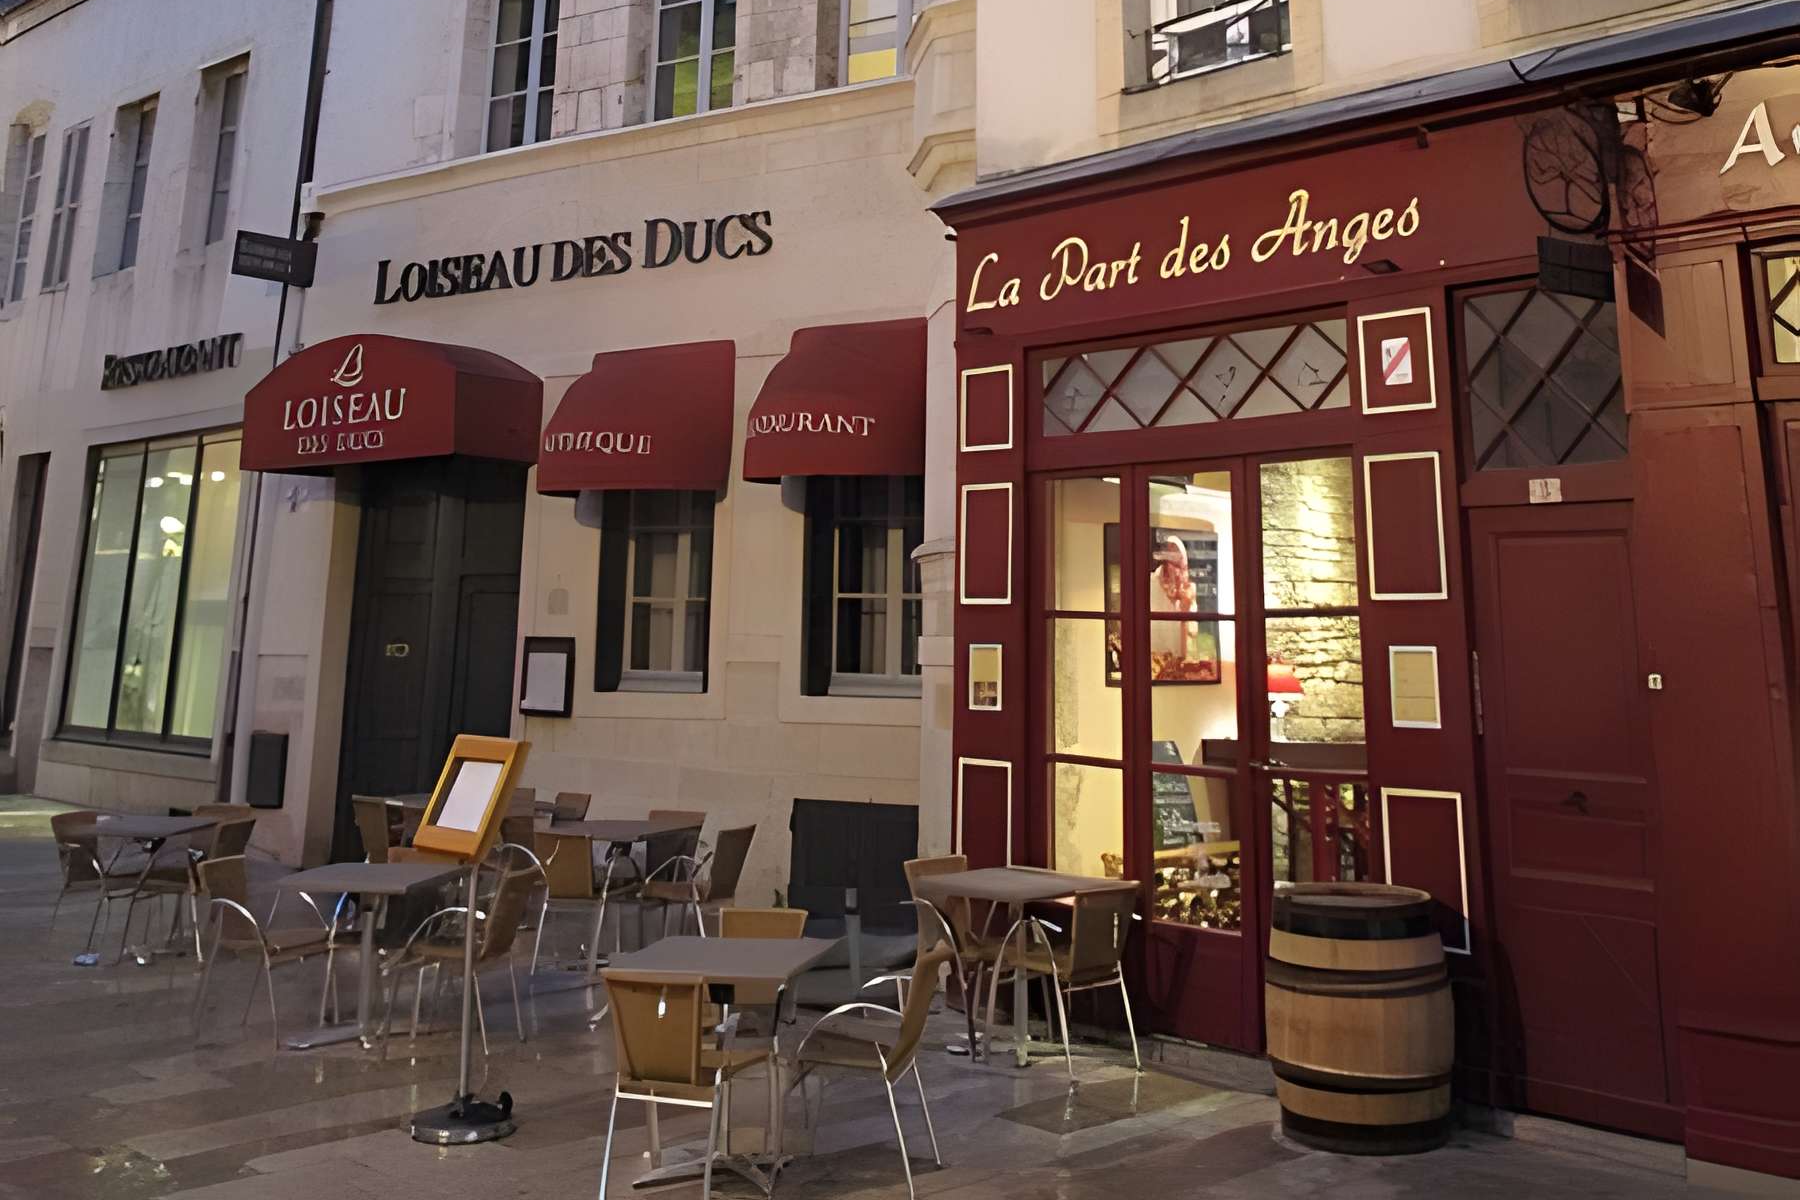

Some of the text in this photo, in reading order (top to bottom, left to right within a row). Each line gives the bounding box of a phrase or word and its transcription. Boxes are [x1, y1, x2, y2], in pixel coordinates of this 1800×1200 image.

[1719, 101, 1800, 177] A
[550, 231, 633, 283] DES
[641, 209, 774, 269] DUCS
[965, 188, 1421, 314] La Part des Anges
[283, 387, 406, 431] LOISEAU
